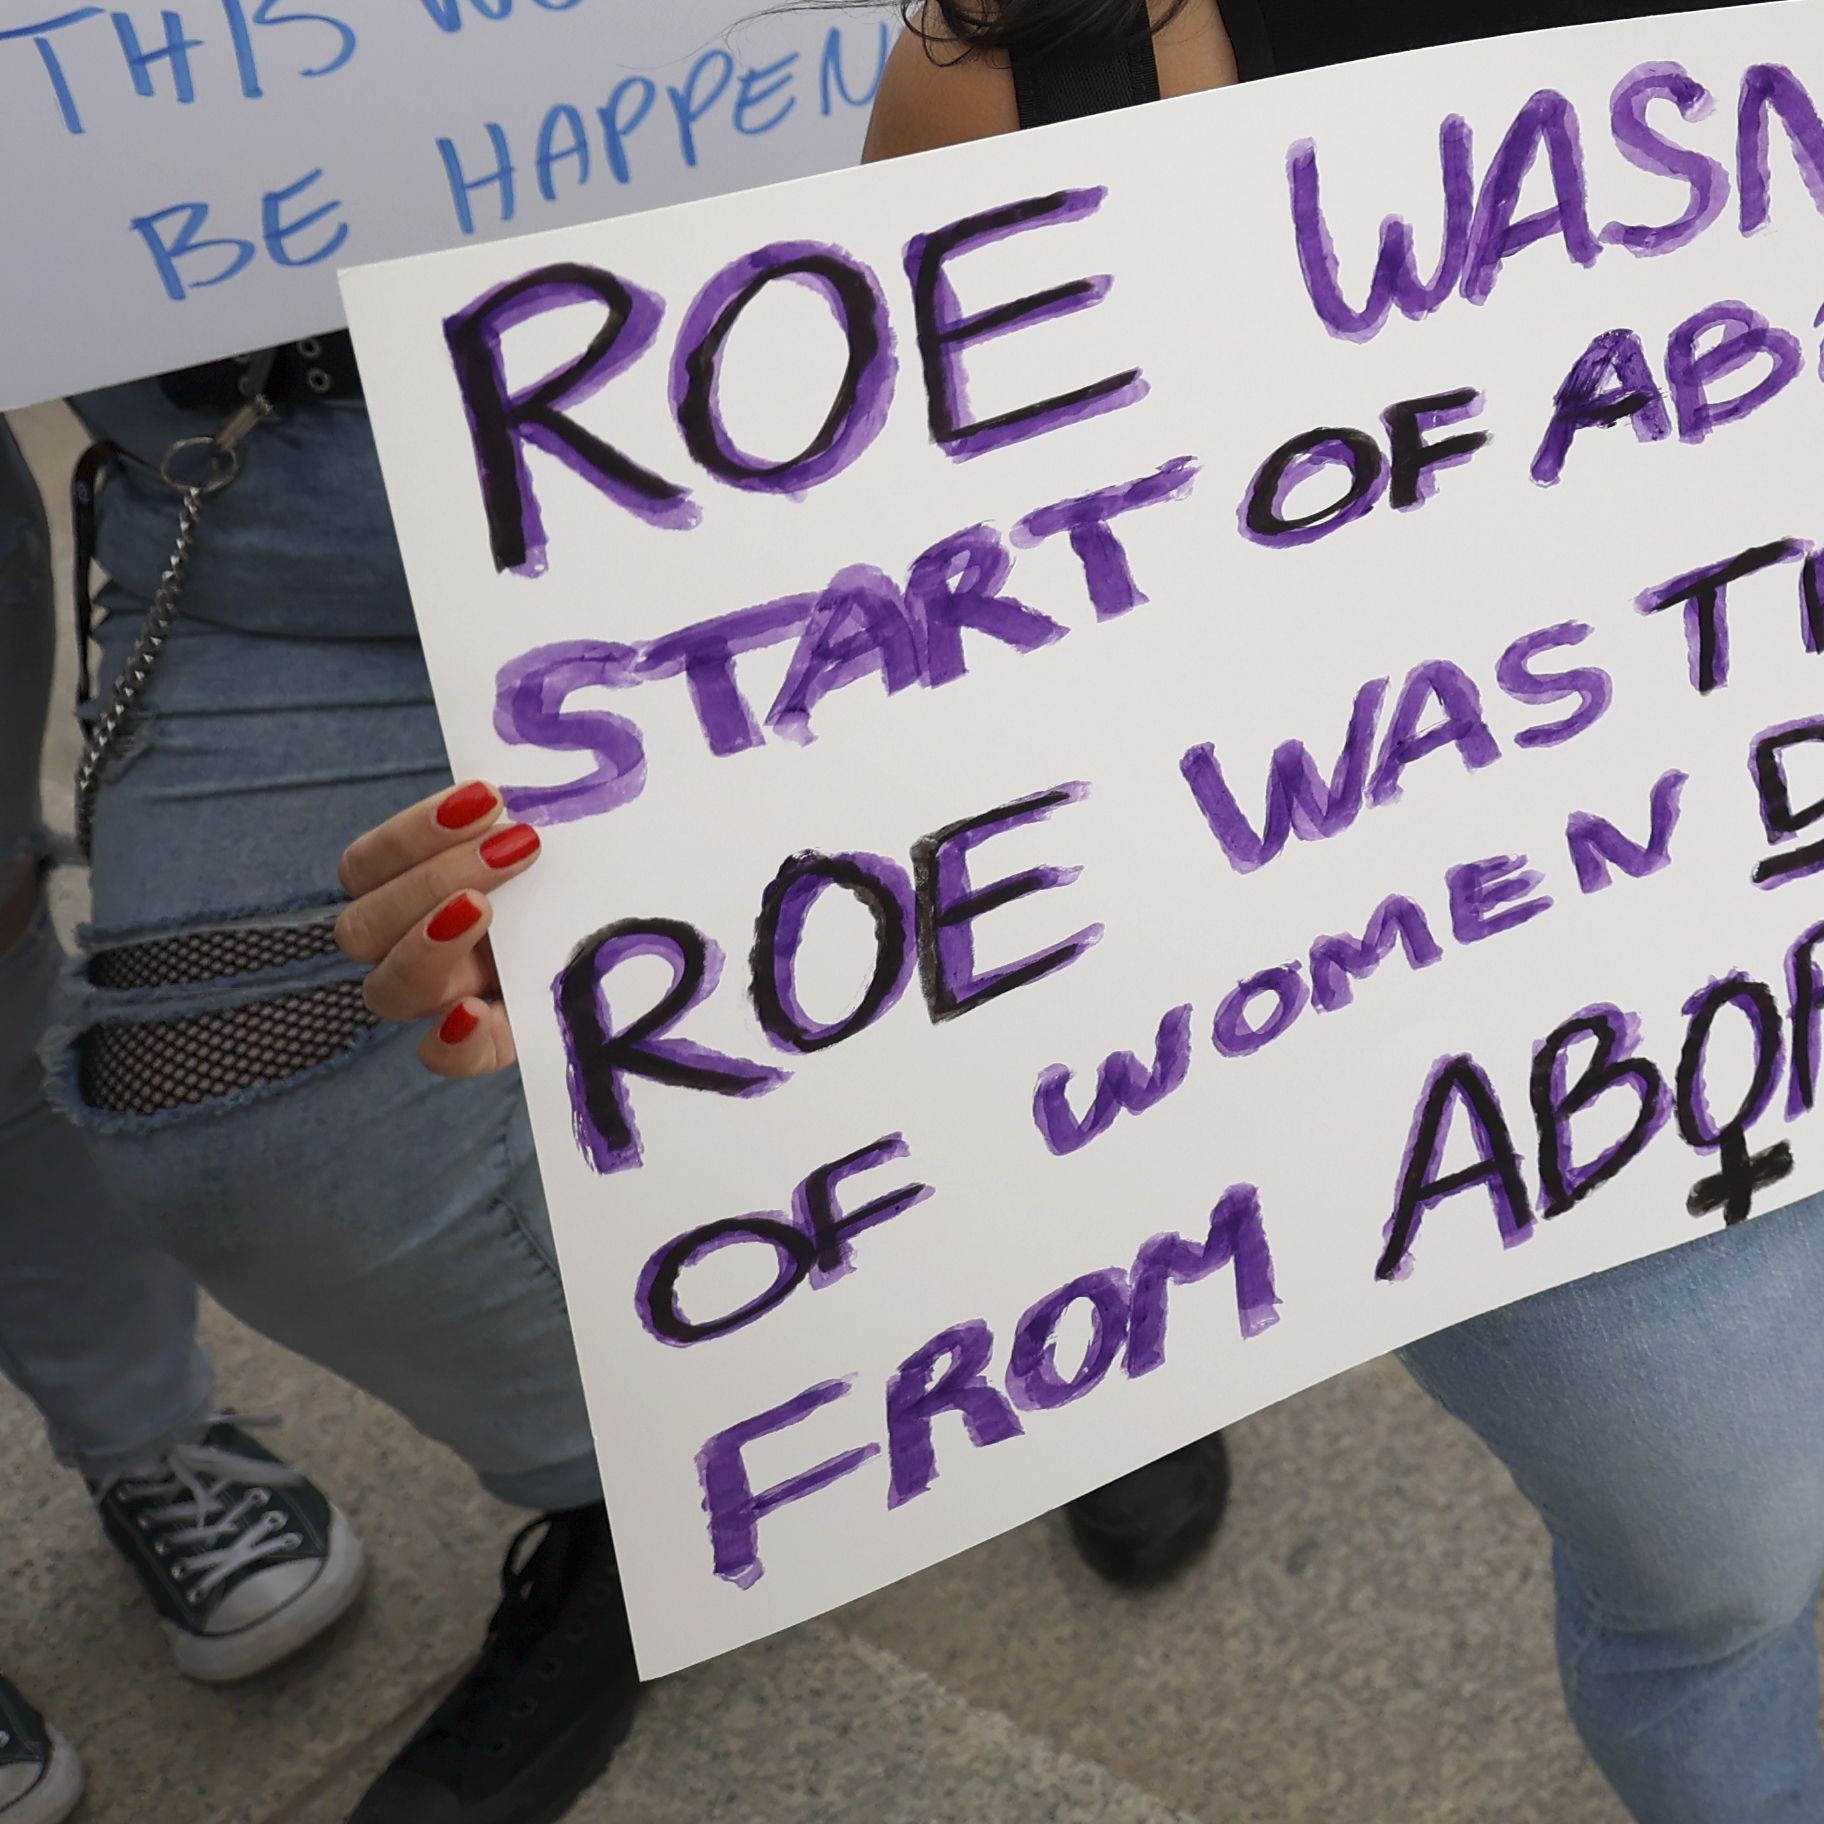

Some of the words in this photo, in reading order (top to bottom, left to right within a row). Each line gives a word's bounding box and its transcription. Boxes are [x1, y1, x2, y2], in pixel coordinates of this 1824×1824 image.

[131, 167, 350, 303] BE
[443, 183, 1150, 579] ROE
[492, 453, 1202, 826] START
[1237, 386, 1492, 551] OF
[551, 779, 1106, 1175] ROE
[1178, 617, 1613, 873] WAS
[634, 1130, 936, 1348] OF
[1031, 768, 1688, 1157] WOMEN
[694, 1181, 1284, 1591] FROM
